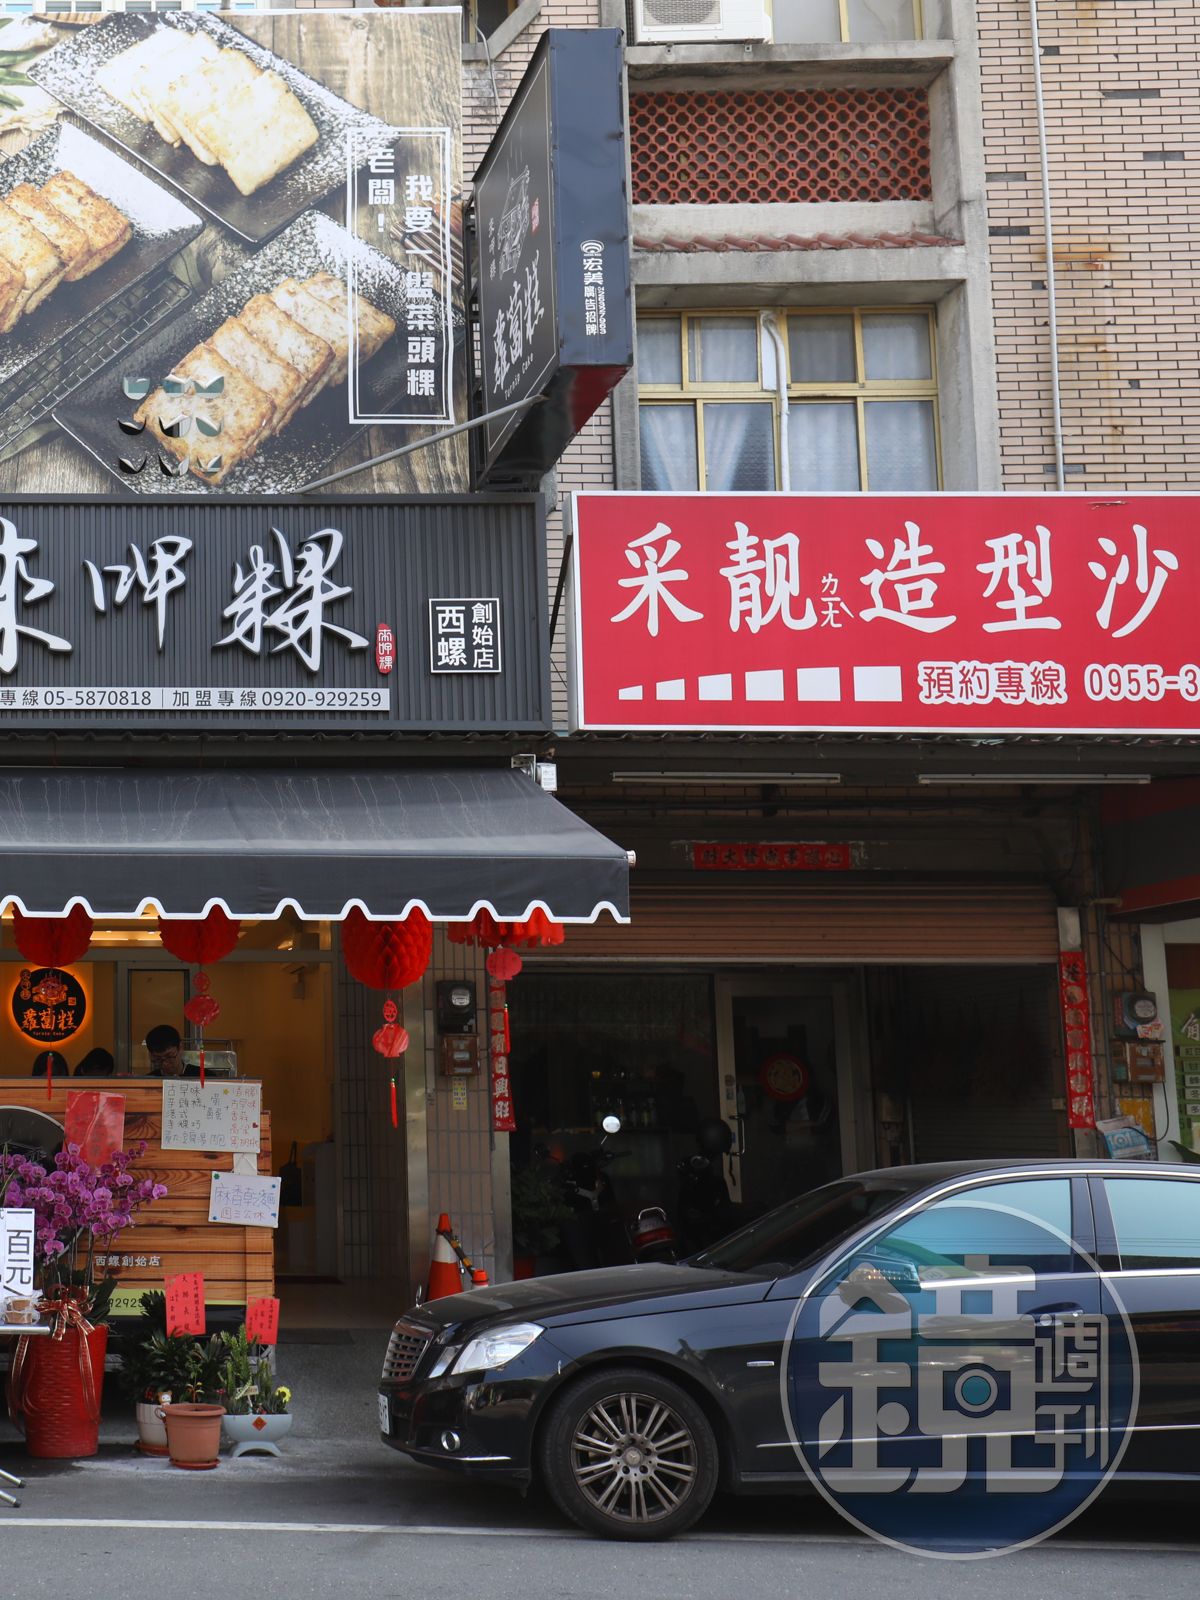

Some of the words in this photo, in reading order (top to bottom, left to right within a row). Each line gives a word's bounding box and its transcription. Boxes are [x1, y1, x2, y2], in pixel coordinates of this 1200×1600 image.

[406, 174, 435, 396] 我要一盤菜頭粿
[436, 606, 467, 666] 西螺
[471, 602, 494, 668] 創始店
[921, 664, 1066, 702] 預約專線
